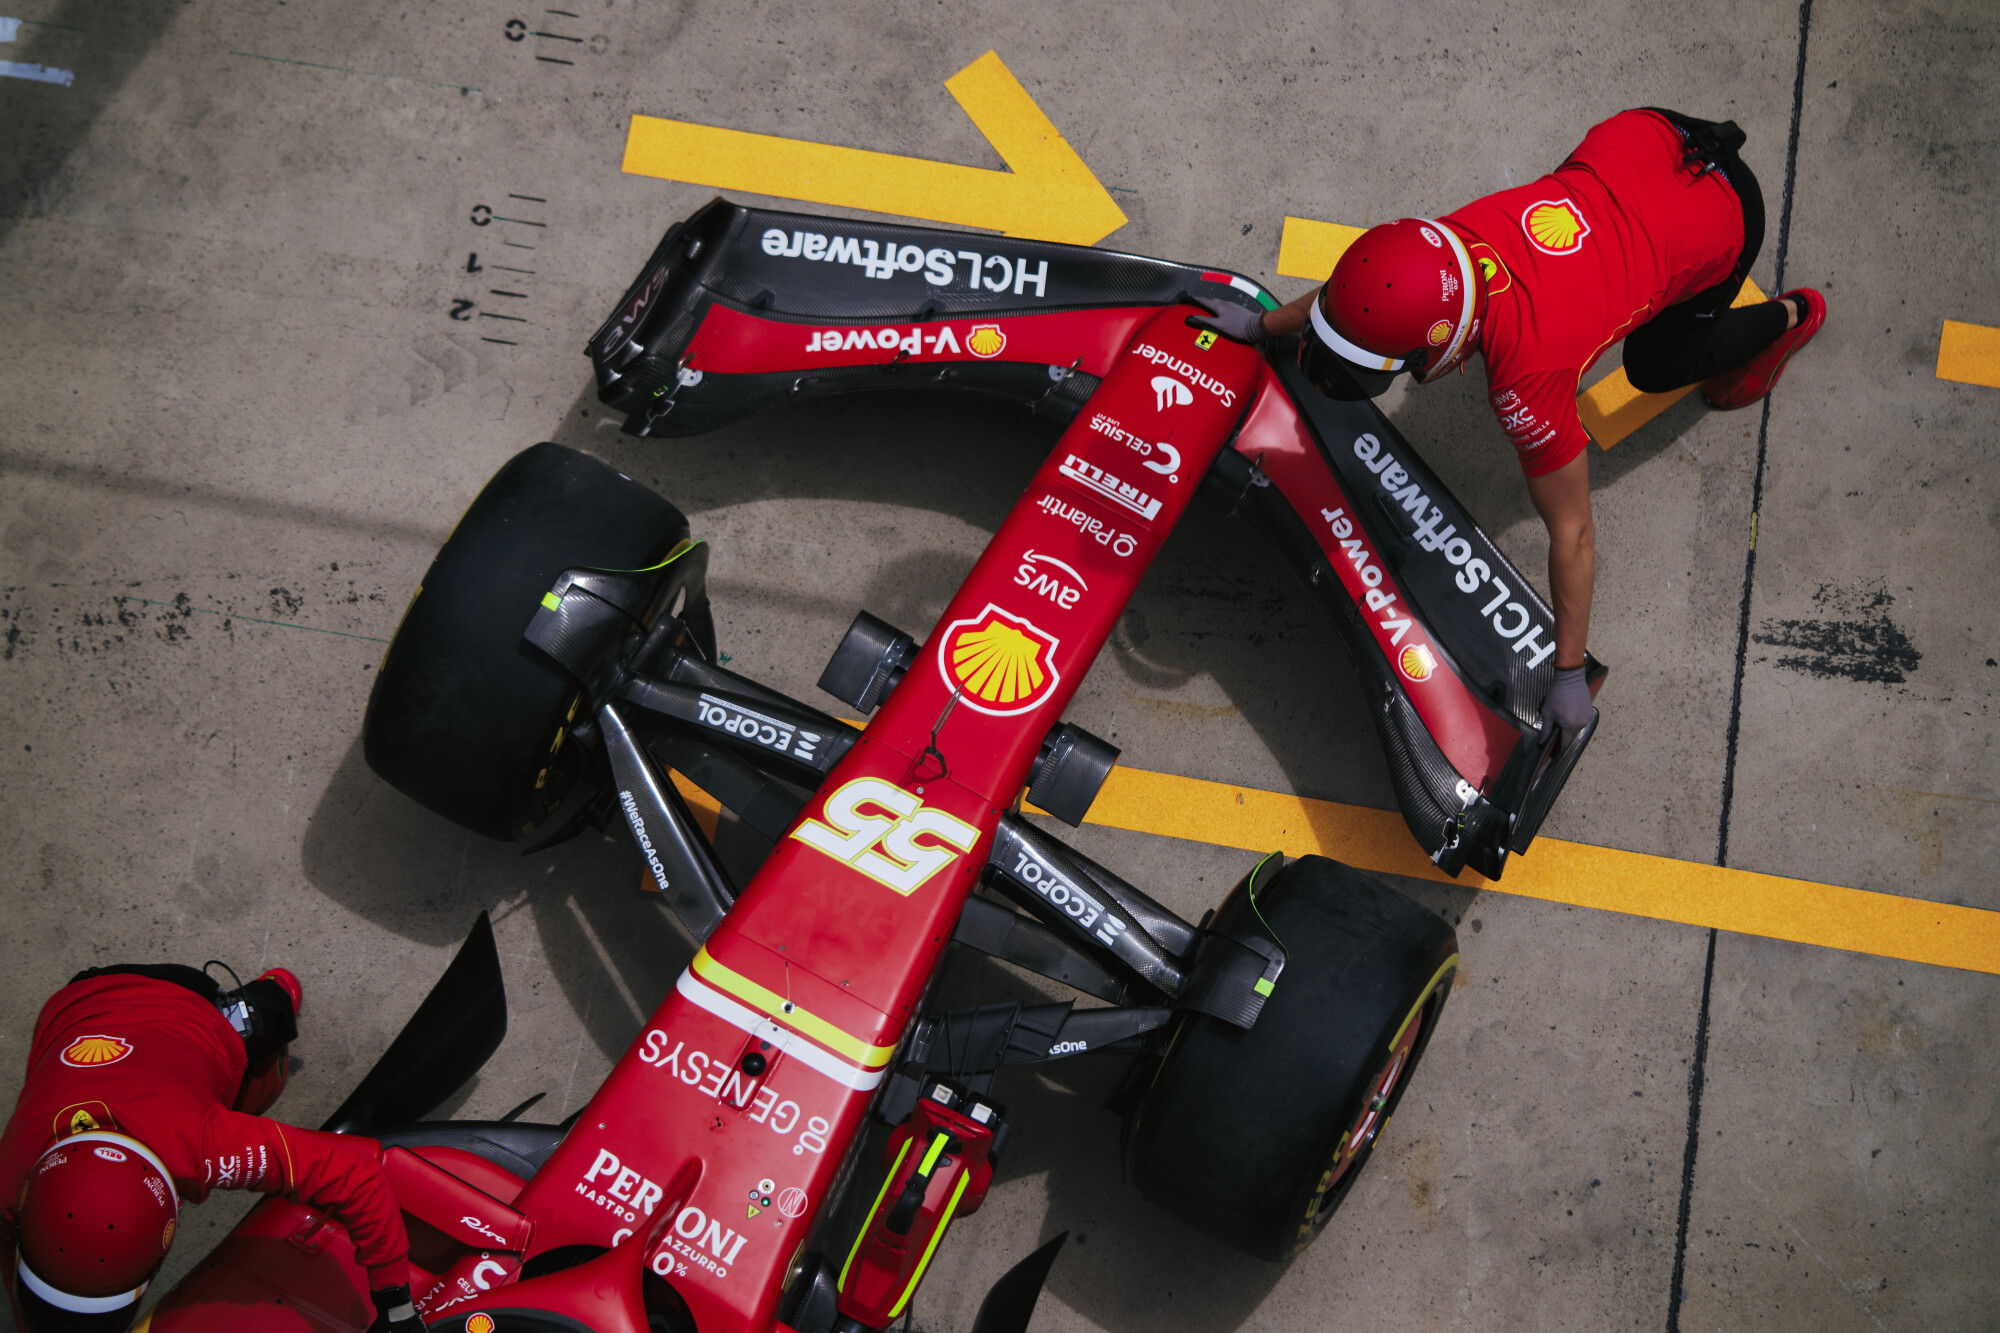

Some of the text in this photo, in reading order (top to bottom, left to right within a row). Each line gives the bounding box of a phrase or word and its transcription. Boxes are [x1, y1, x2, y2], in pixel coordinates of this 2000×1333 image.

[505, 19, 526, 42] 0
[470, 204, 492, 227] 0
[466, 252, 482, 274] 1
[761, 229, 1049, 297] HCLSoftware
[1440, 269, 1449, 302] PERONI
[450, 299, 474, 321] 2
[602, 265, 669, 354] aws
[806, 326, 961, 355] V-Power
[1133, 343, 1236, 408] Santander
[1495, 389, 1517, 406] aws
[1089, 416, 1152, 456] CELSIUS
[1531, 420, 1551, 437] MILLE
[1058, 453, 1163, 521] PIRELLI
[1036, 494, 1117, 546] Palantir
[1353, 432, 1556, 670] HCLSoftware
[1013, 563, 1081, 610] aws
[1321, 506, 1412, 646] V-Power
[698, 701, 793, 751] ECOPOL
[619, 790, 669, 890] #WeRaceAsOne
[789, 776, 982, 897] 55
[1014, 852, 1099, 928] ECOPOL
[638, 1029, 801, 1135] GENESYS
[39, 1157, 68, 1175] PERONI
[143, 1177, 165, 1206] PERONI
[460, 1216, 506, 1245] Riva
[575, 1182, 727, 1278] NASTRO AZZURRO
